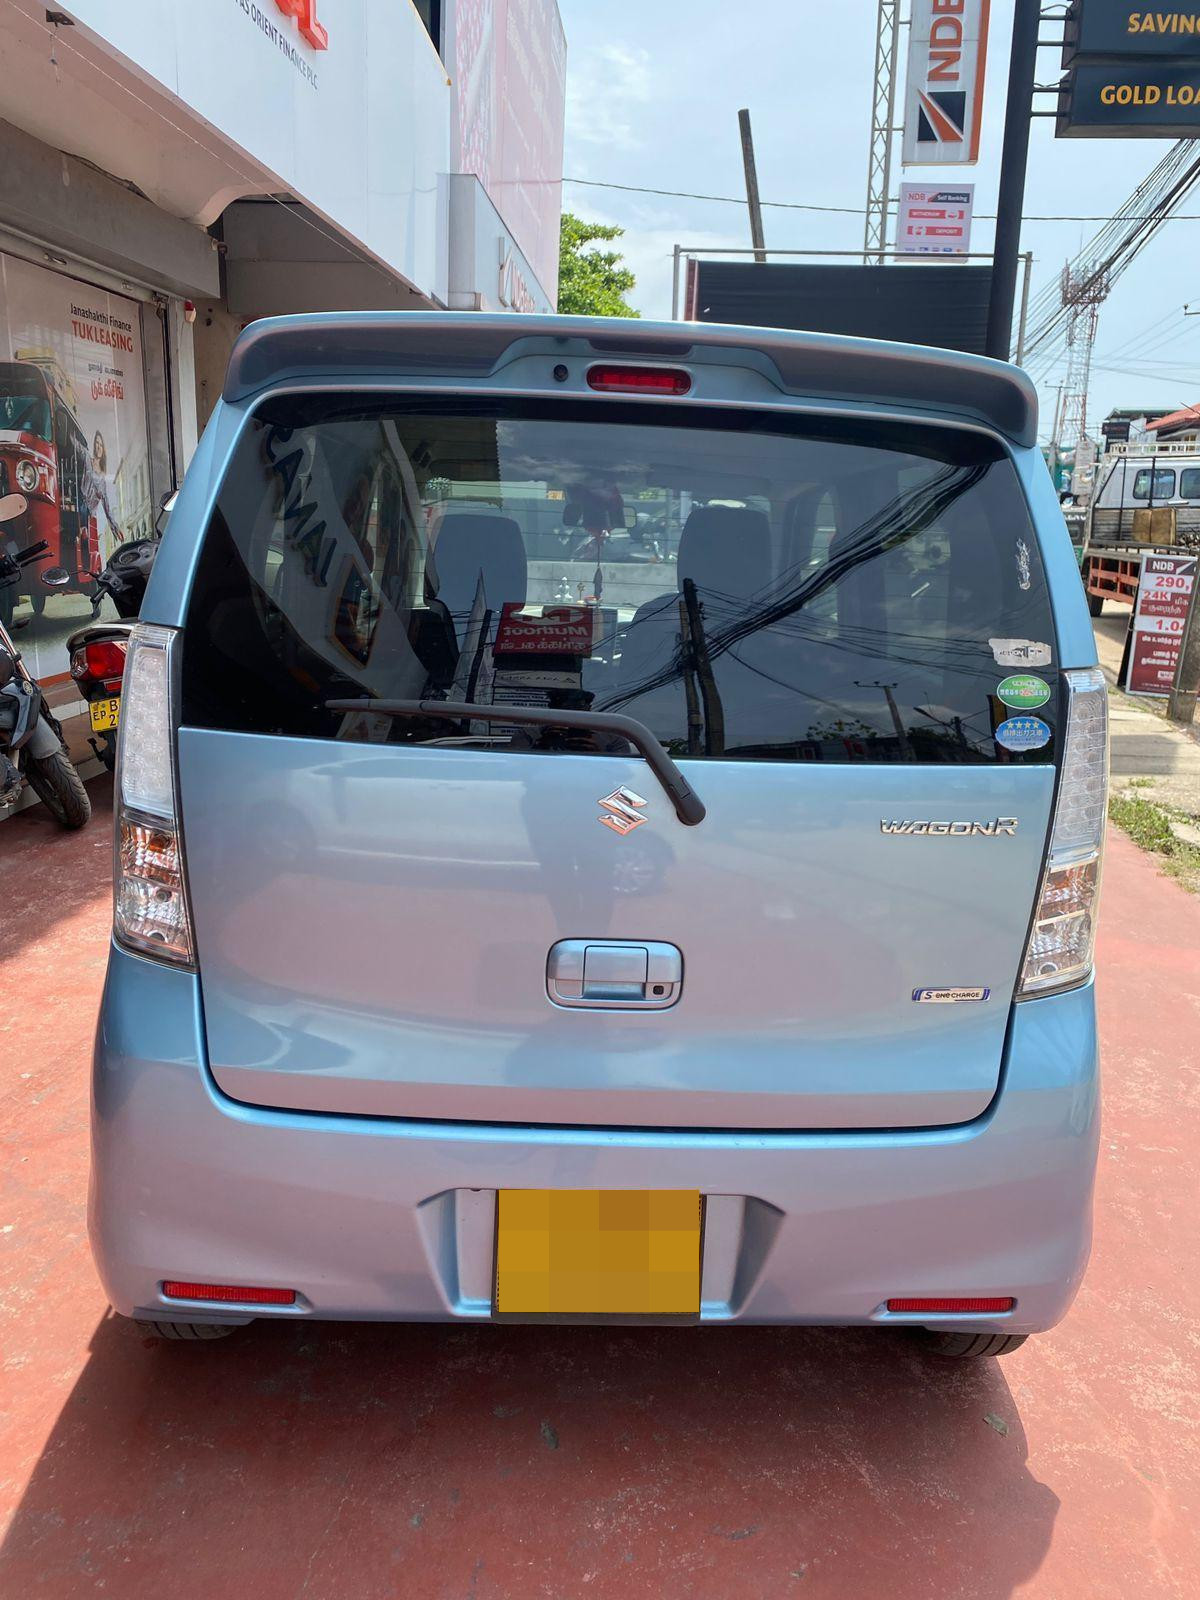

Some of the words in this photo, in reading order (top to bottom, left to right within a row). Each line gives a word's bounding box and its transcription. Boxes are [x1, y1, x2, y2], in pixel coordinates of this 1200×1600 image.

[1127, 12, 1200, 34] SAVIN
[251, 4, 278, 45] ORIENT
[279, 34, 306, 77] FINANCE
[306, 65, 318, 90] PLC
[1100, 84, 1161, 105] GOLD
[70, 303, 109, 324] Janashakthi
[109, 316, 132, 332] Finance
[1152, 560, 1175, 571] NDB
[1143, 590, 1168, 600] 24K
[93, 711, 107, 721] EP
